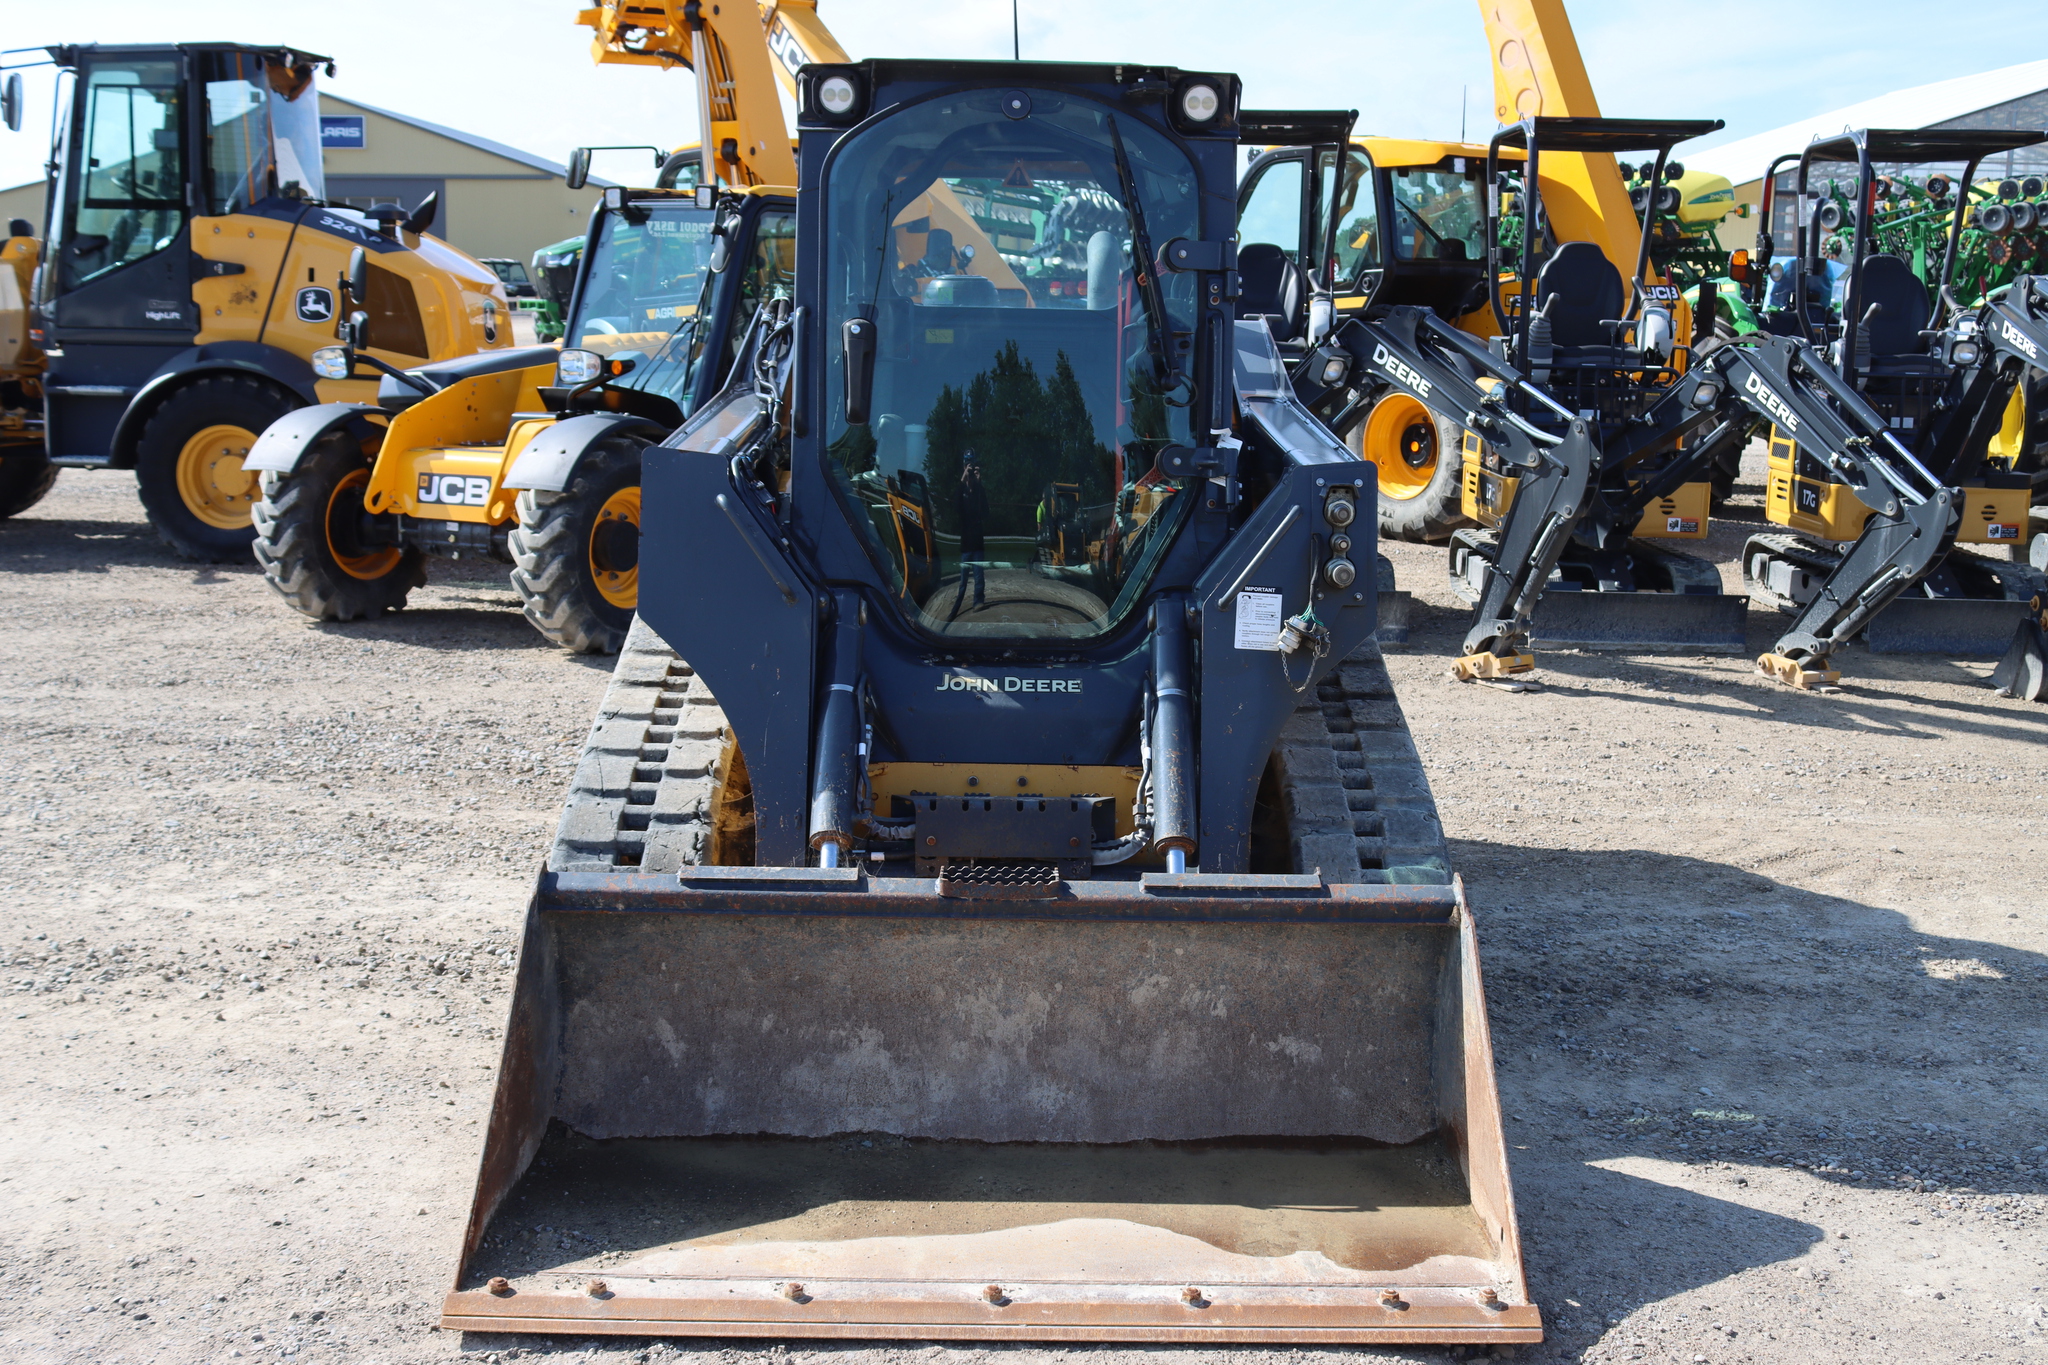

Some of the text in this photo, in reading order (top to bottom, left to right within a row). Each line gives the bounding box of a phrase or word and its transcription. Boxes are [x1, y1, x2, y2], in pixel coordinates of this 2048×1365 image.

[770, 28, 813, 77] JC
[320, 215, 357, 234] 324
[1647, 286, 1679, 299] JCB
[2002, 319, 2037, 360] DEERE
[1372, 343, 1433, 399] DEERE
[1744, 371, 1800, 432] DEERE
[418, 475, 491, 506] JCB
[1803, 489, 1816, 508] 17G
[936, 673, 1082, 692] JOHN DEERE
